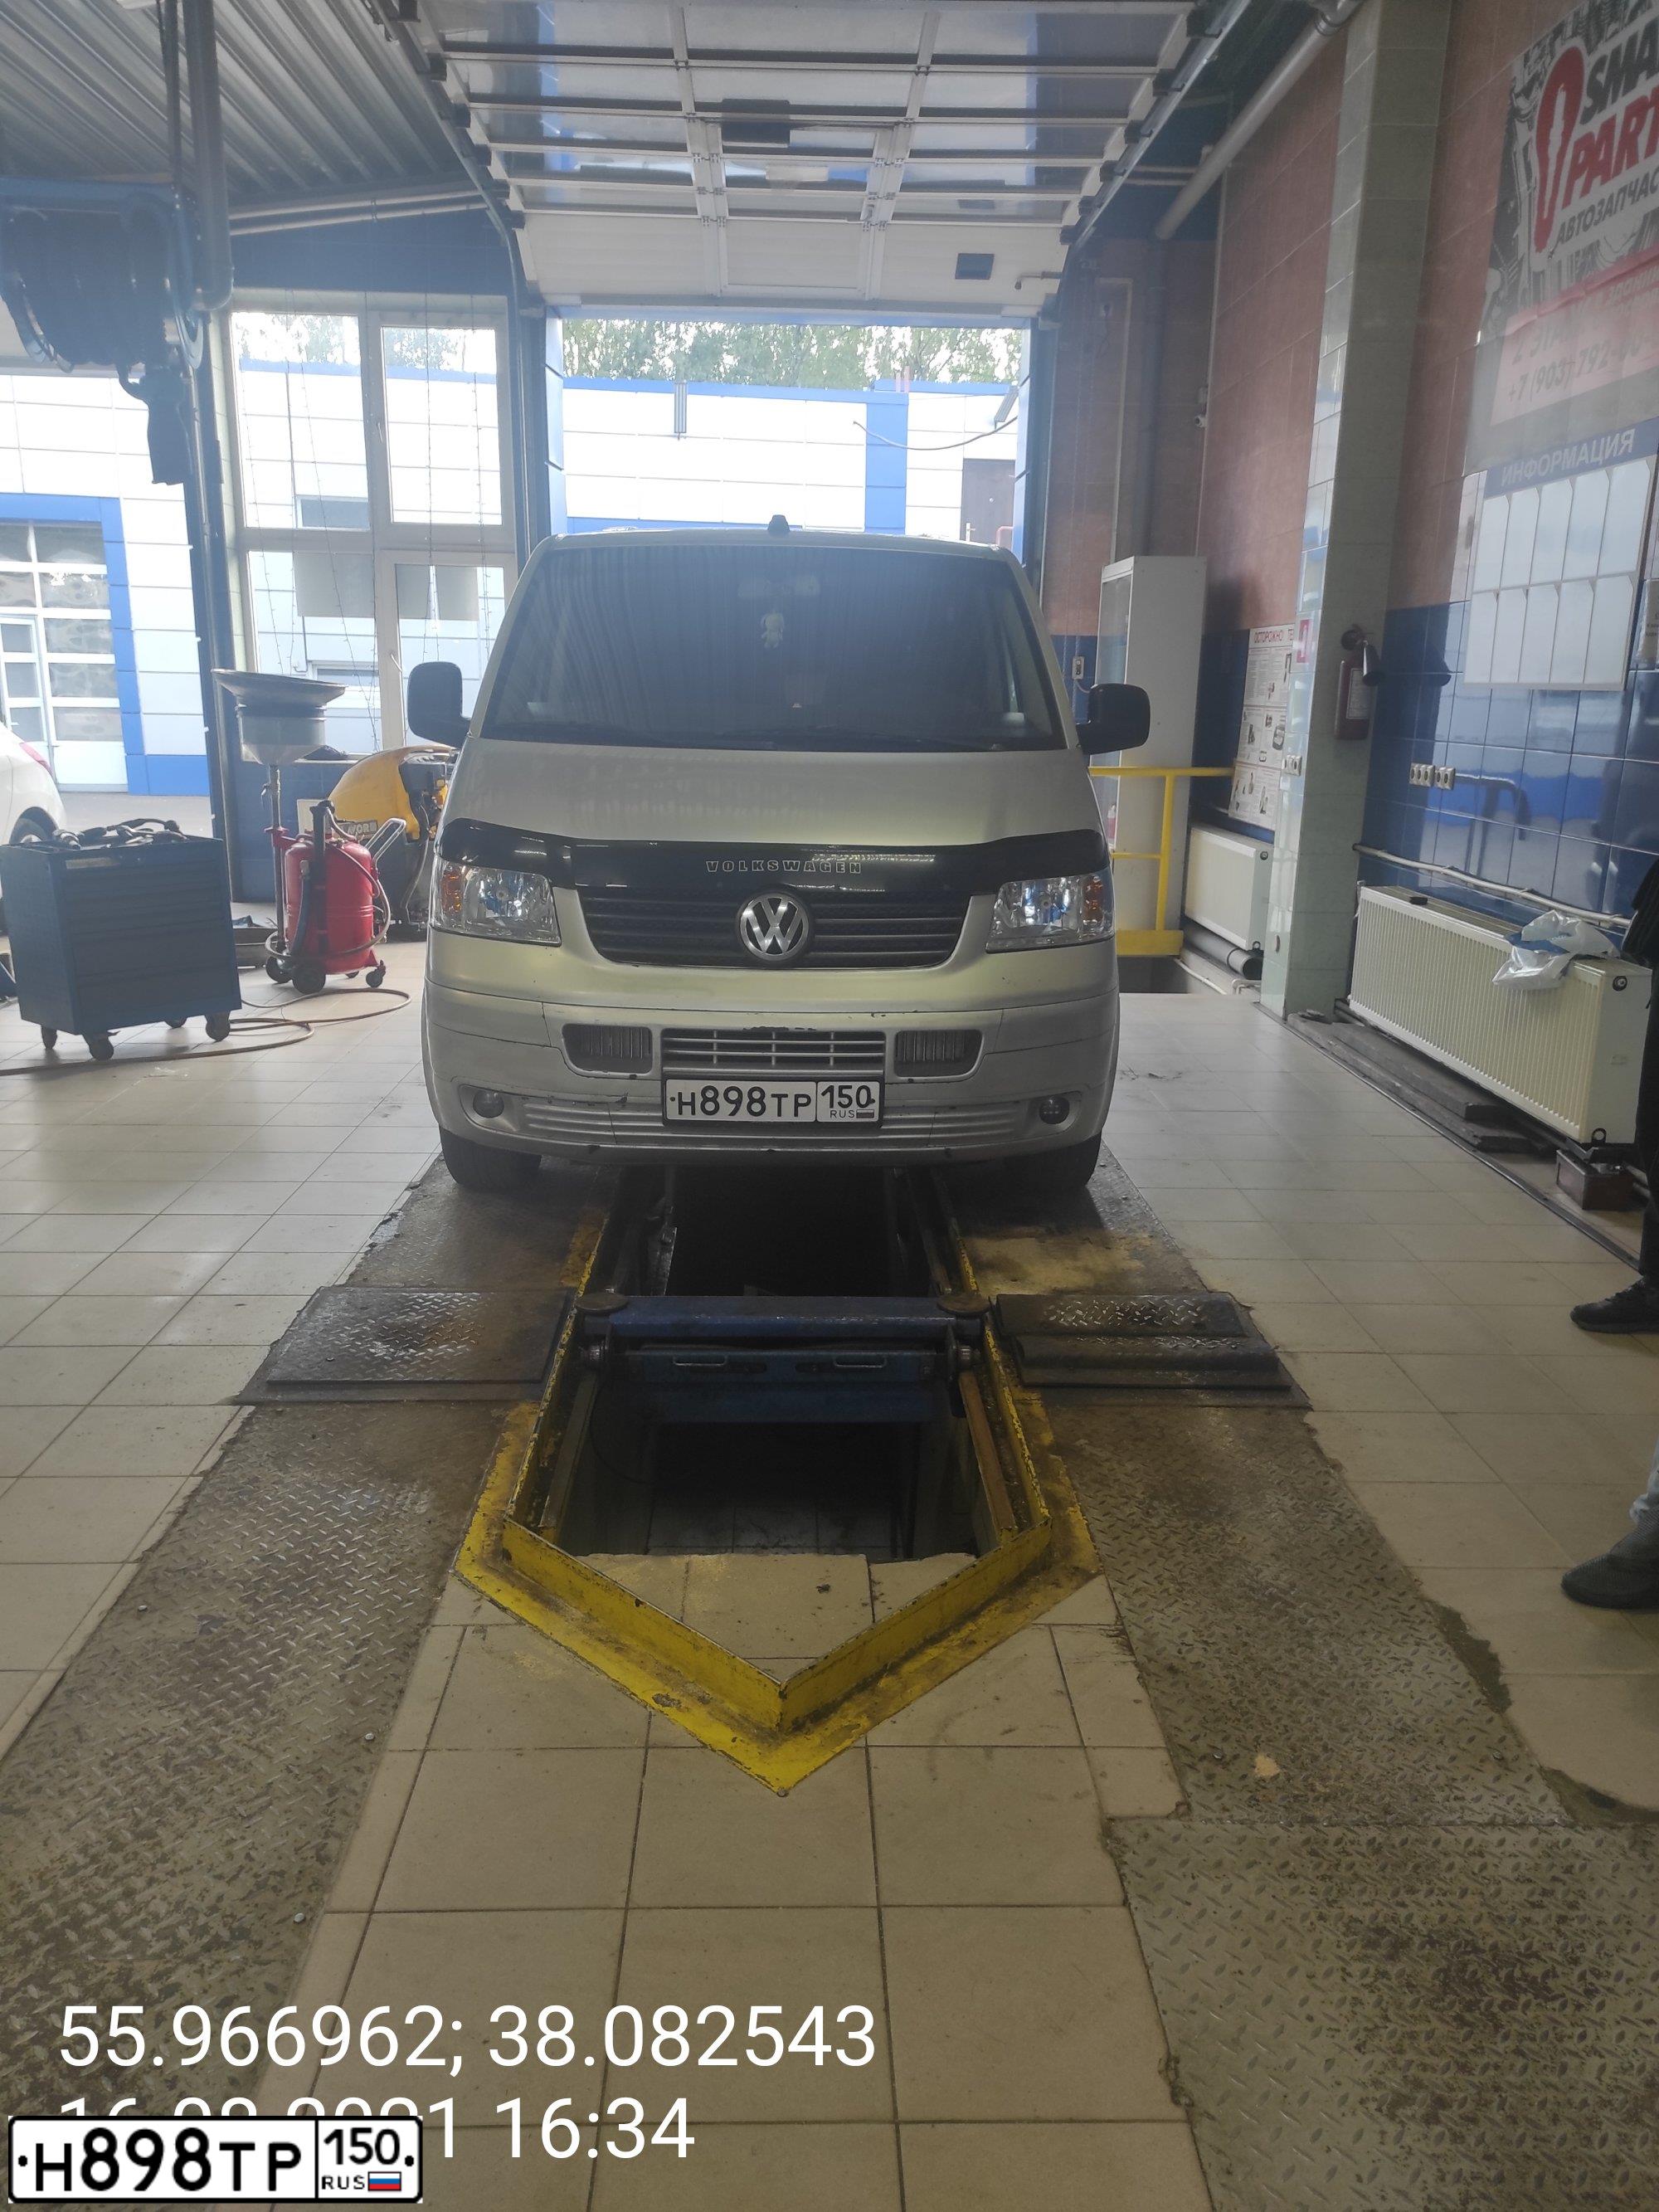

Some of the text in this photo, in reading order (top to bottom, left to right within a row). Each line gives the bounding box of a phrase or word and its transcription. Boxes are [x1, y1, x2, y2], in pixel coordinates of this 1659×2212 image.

[1500, 428, 1636, 486] ИНФОРМАЦИЯ
[706, 860, 862, 874] VOLKSWAGEN
[677, 1084, 873, 1118] Н898ТР 150
[830, 1109, 854, 1119] RUS
